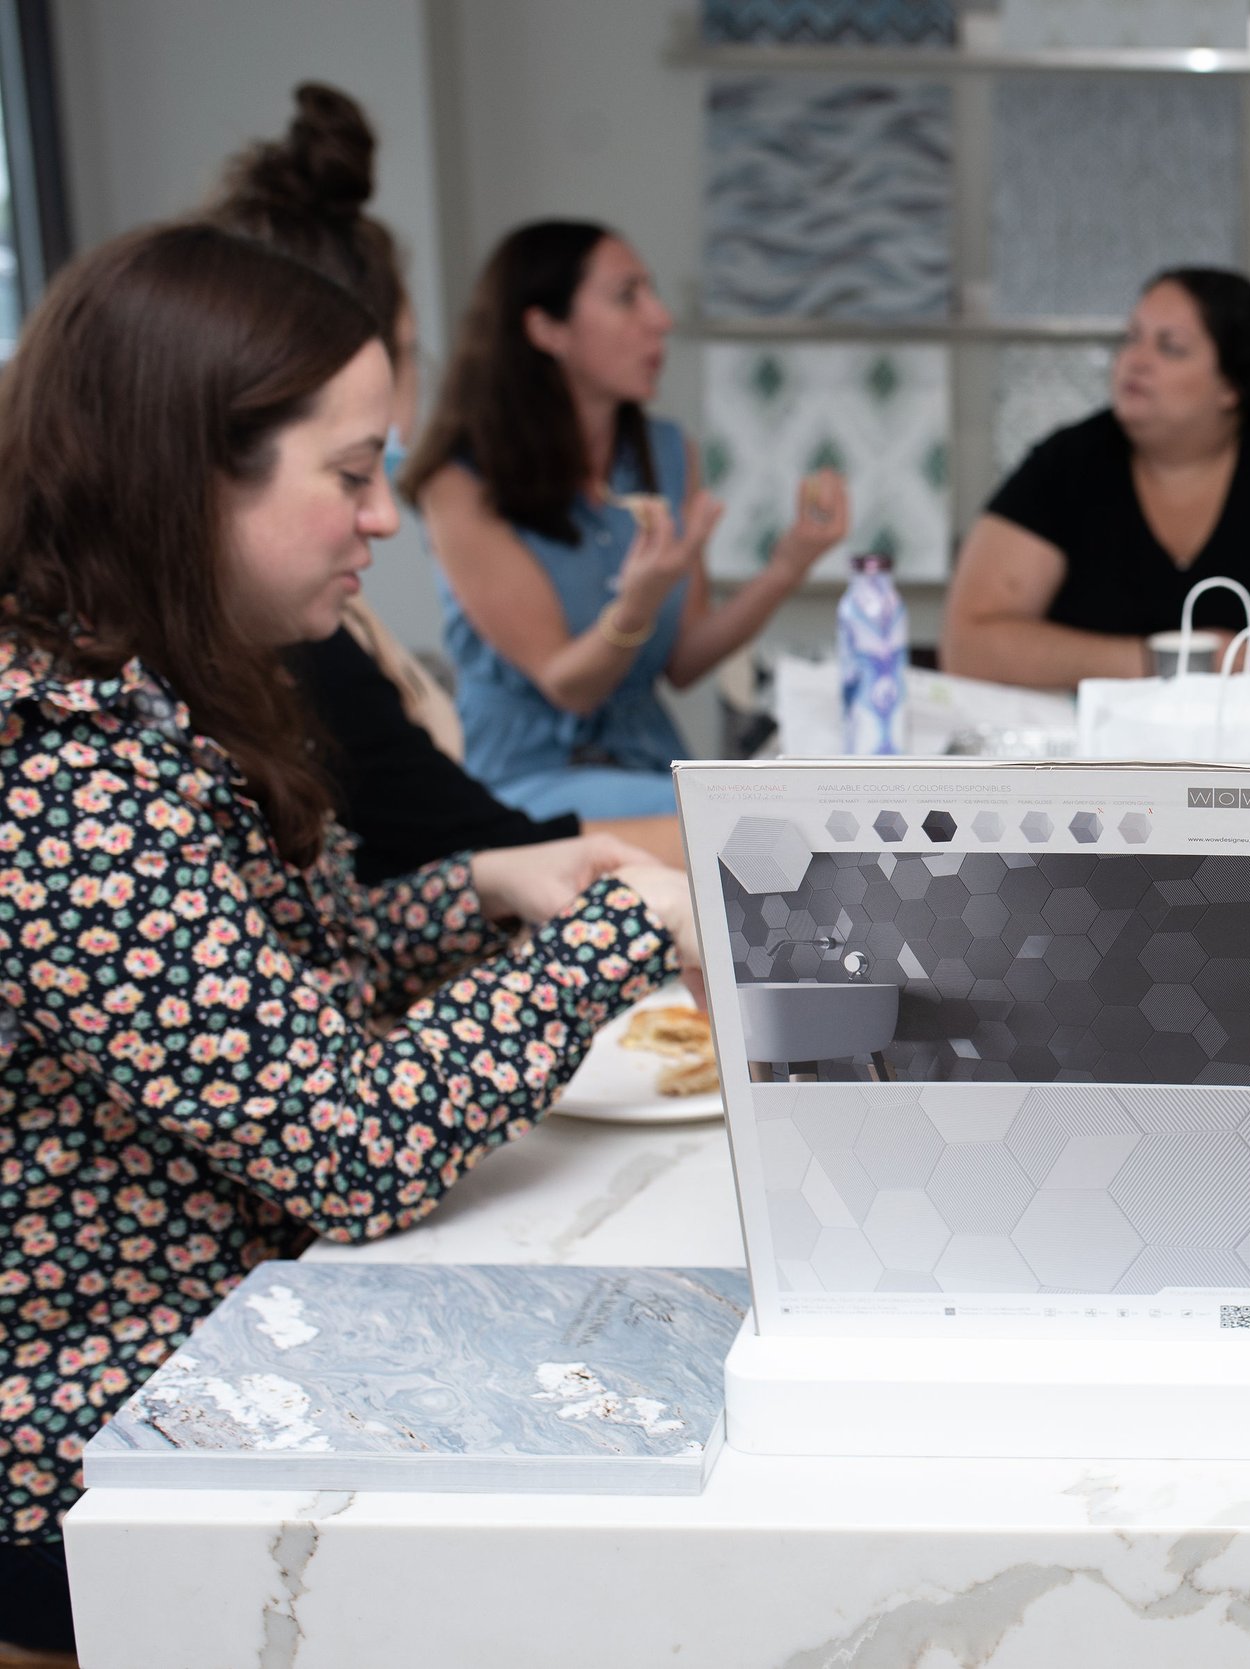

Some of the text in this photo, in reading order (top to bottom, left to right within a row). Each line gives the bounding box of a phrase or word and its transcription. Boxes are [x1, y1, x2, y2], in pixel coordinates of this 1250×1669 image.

[707, 784, 788, 792] MINI HEXA CANALE
[817, 784, 861, 792] AVAILABLE
[863, 784, 905, 792] COLOURS
[956, 785, 1011, 793] DISPONIBLES
